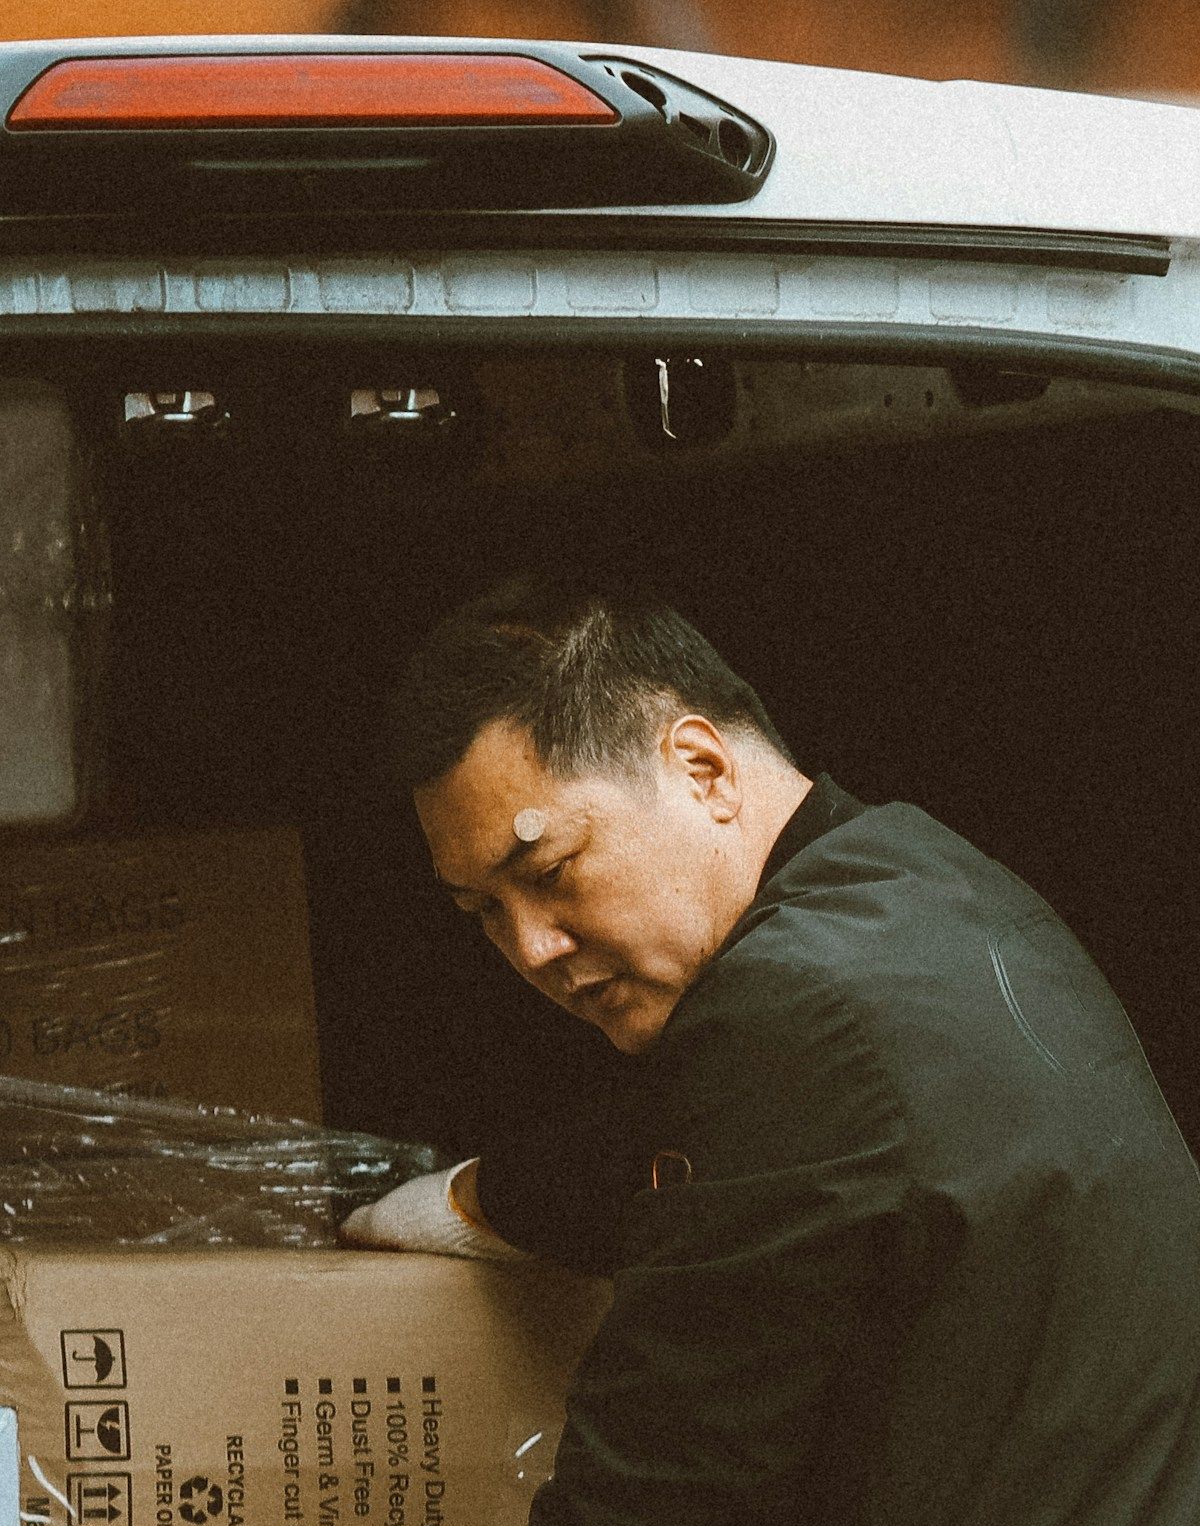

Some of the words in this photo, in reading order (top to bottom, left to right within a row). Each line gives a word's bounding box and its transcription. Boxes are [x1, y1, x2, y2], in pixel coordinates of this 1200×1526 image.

[278, 1401, 302, 1479] Finger
[315, 1401, 337, 1467] Germ
[351, 1401, 372, 1456] Dust
[386, 1401, 409, 1468] 100%
[420, 1399, 442, 1475] Heavy
[155, 1444, 173, 1505] PAPER
[284, 1484, 304, 1521] cut
[318, 1473, 339, 1491] &
[354, 1461, 374, 1518] Free
